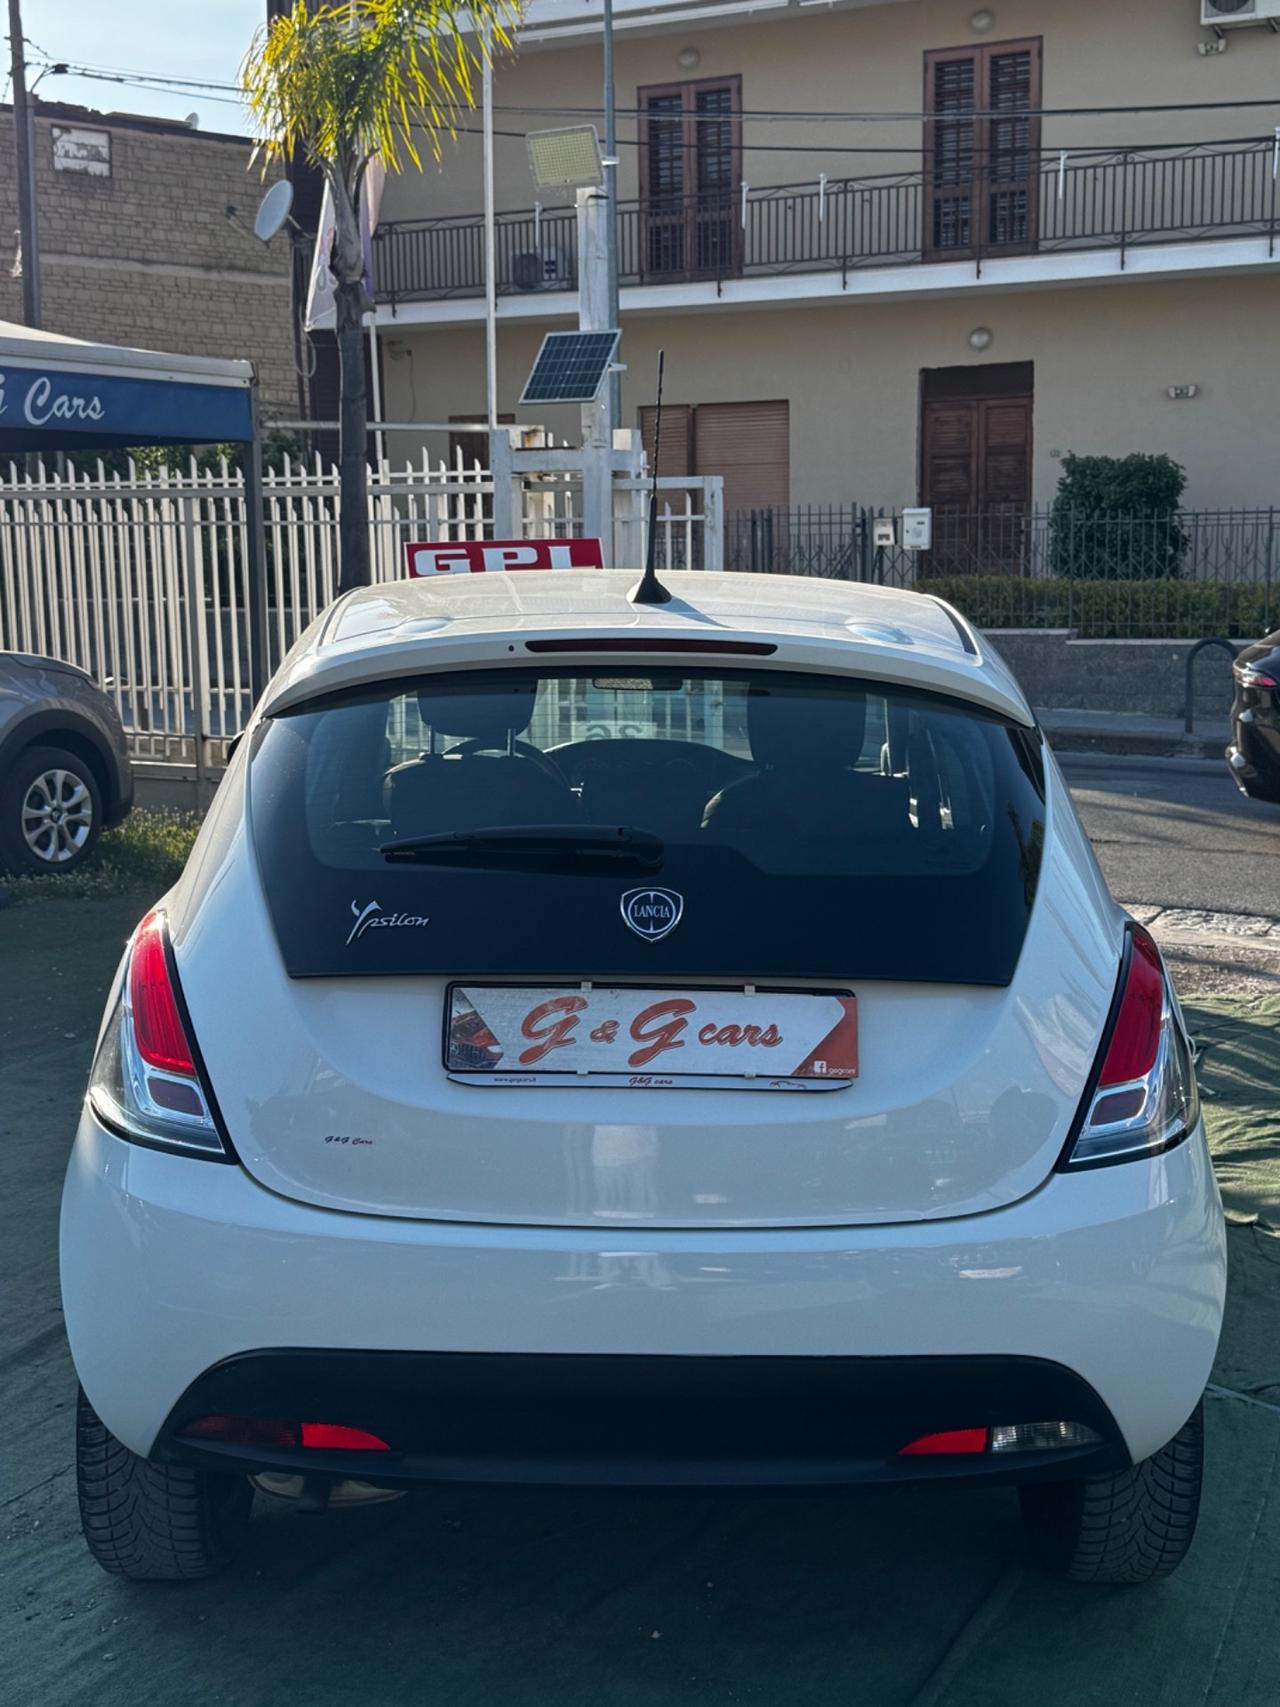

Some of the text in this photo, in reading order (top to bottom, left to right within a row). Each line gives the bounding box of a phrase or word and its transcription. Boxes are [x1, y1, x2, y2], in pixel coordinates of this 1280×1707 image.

[24, 376, 105, 426] Cars
[345, 900, 430, 945] Ypsilon
[633, 904, 671, 918] LANCIA
[519, 995, 784, 1068] G & G cars
